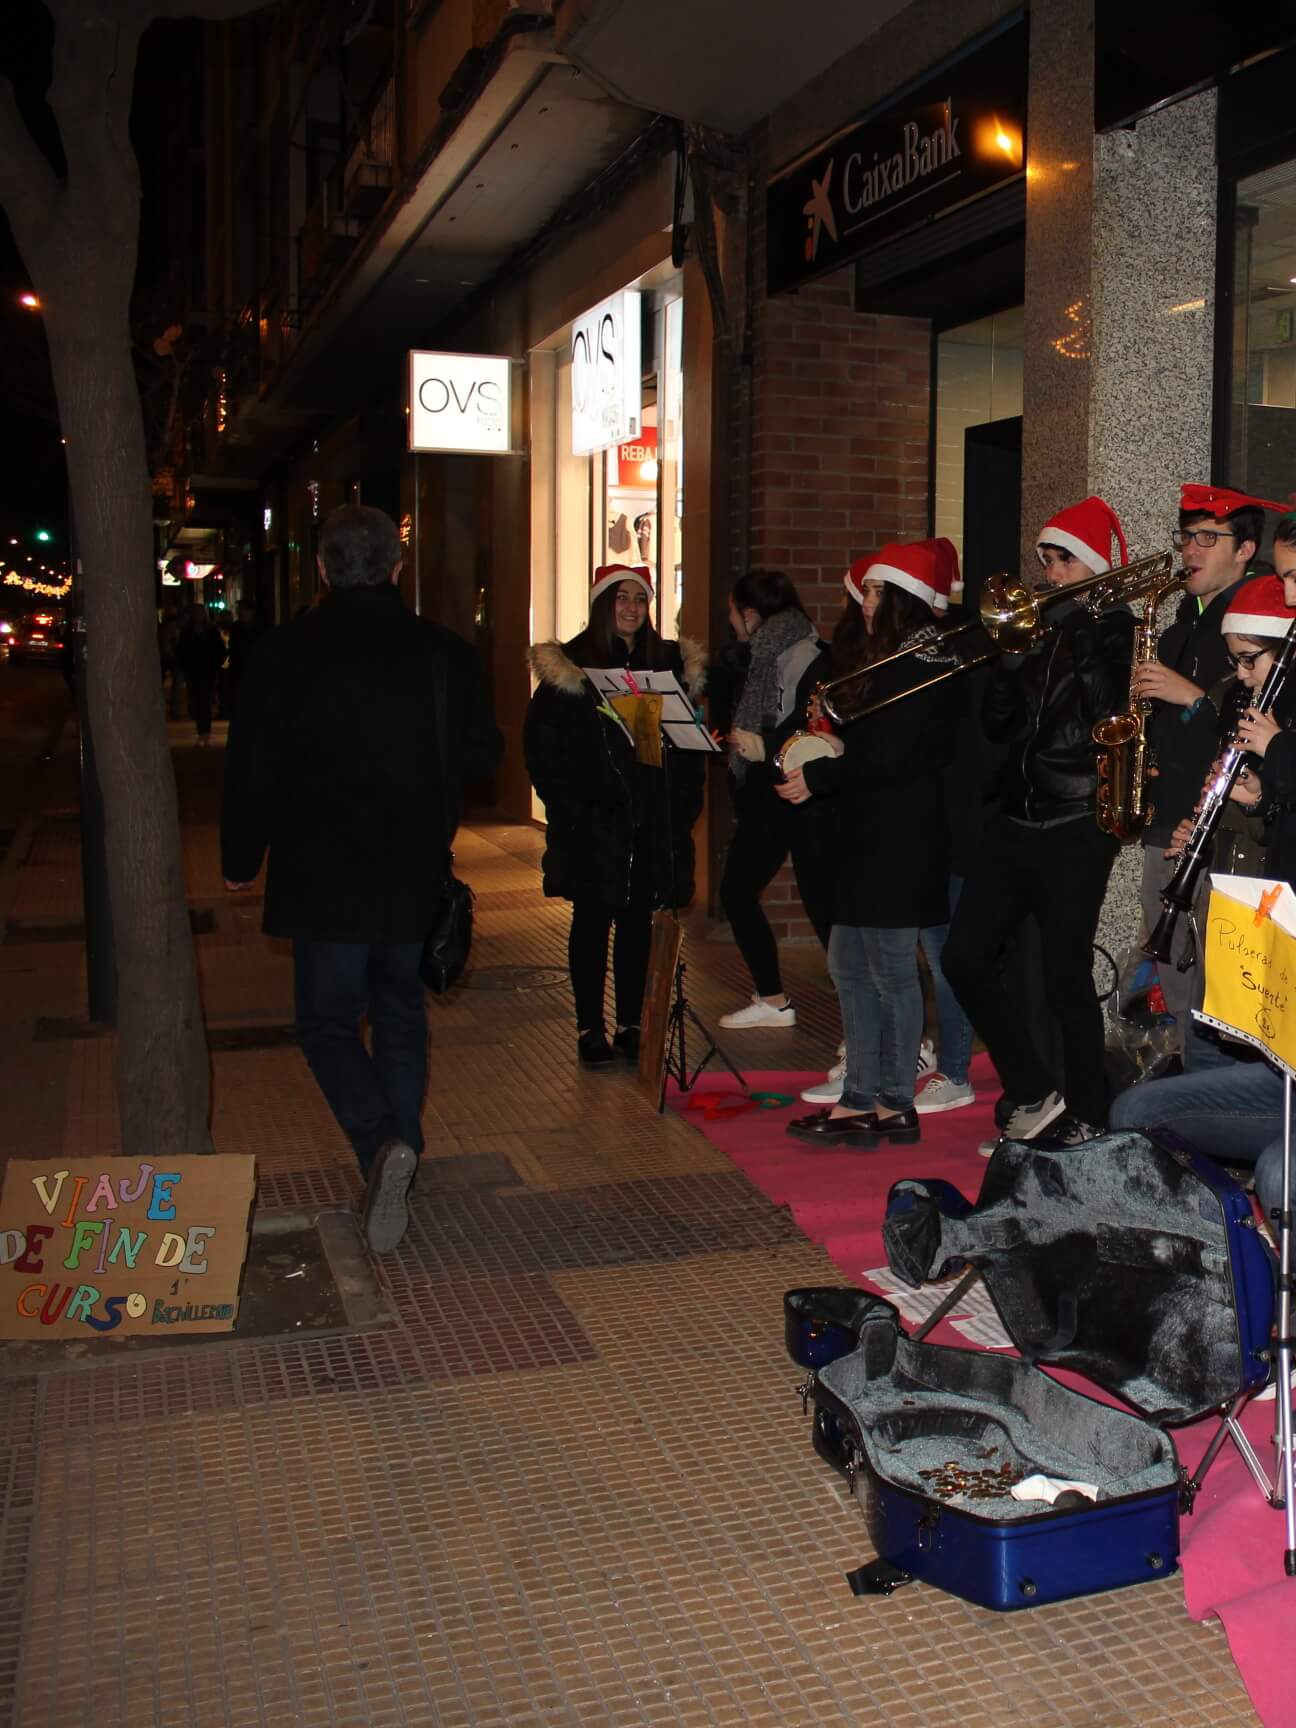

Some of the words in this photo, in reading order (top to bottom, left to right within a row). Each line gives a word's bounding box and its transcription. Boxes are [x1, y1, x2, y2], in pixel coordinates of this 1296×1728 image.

[843, 96, 961, 214] CaixaBank
[418, 378, 502, 414] OVS
[1212, 918, 1272, 968] Pulseras
[32, 1163, 182, 1227] VIAJE
[0, 1225, 55, 1274] DE
[63, 1218, 148, 1274] FIN
[154, 1226, 216, 1274] DE
[17, 1283, 147, 1331] CURSO
